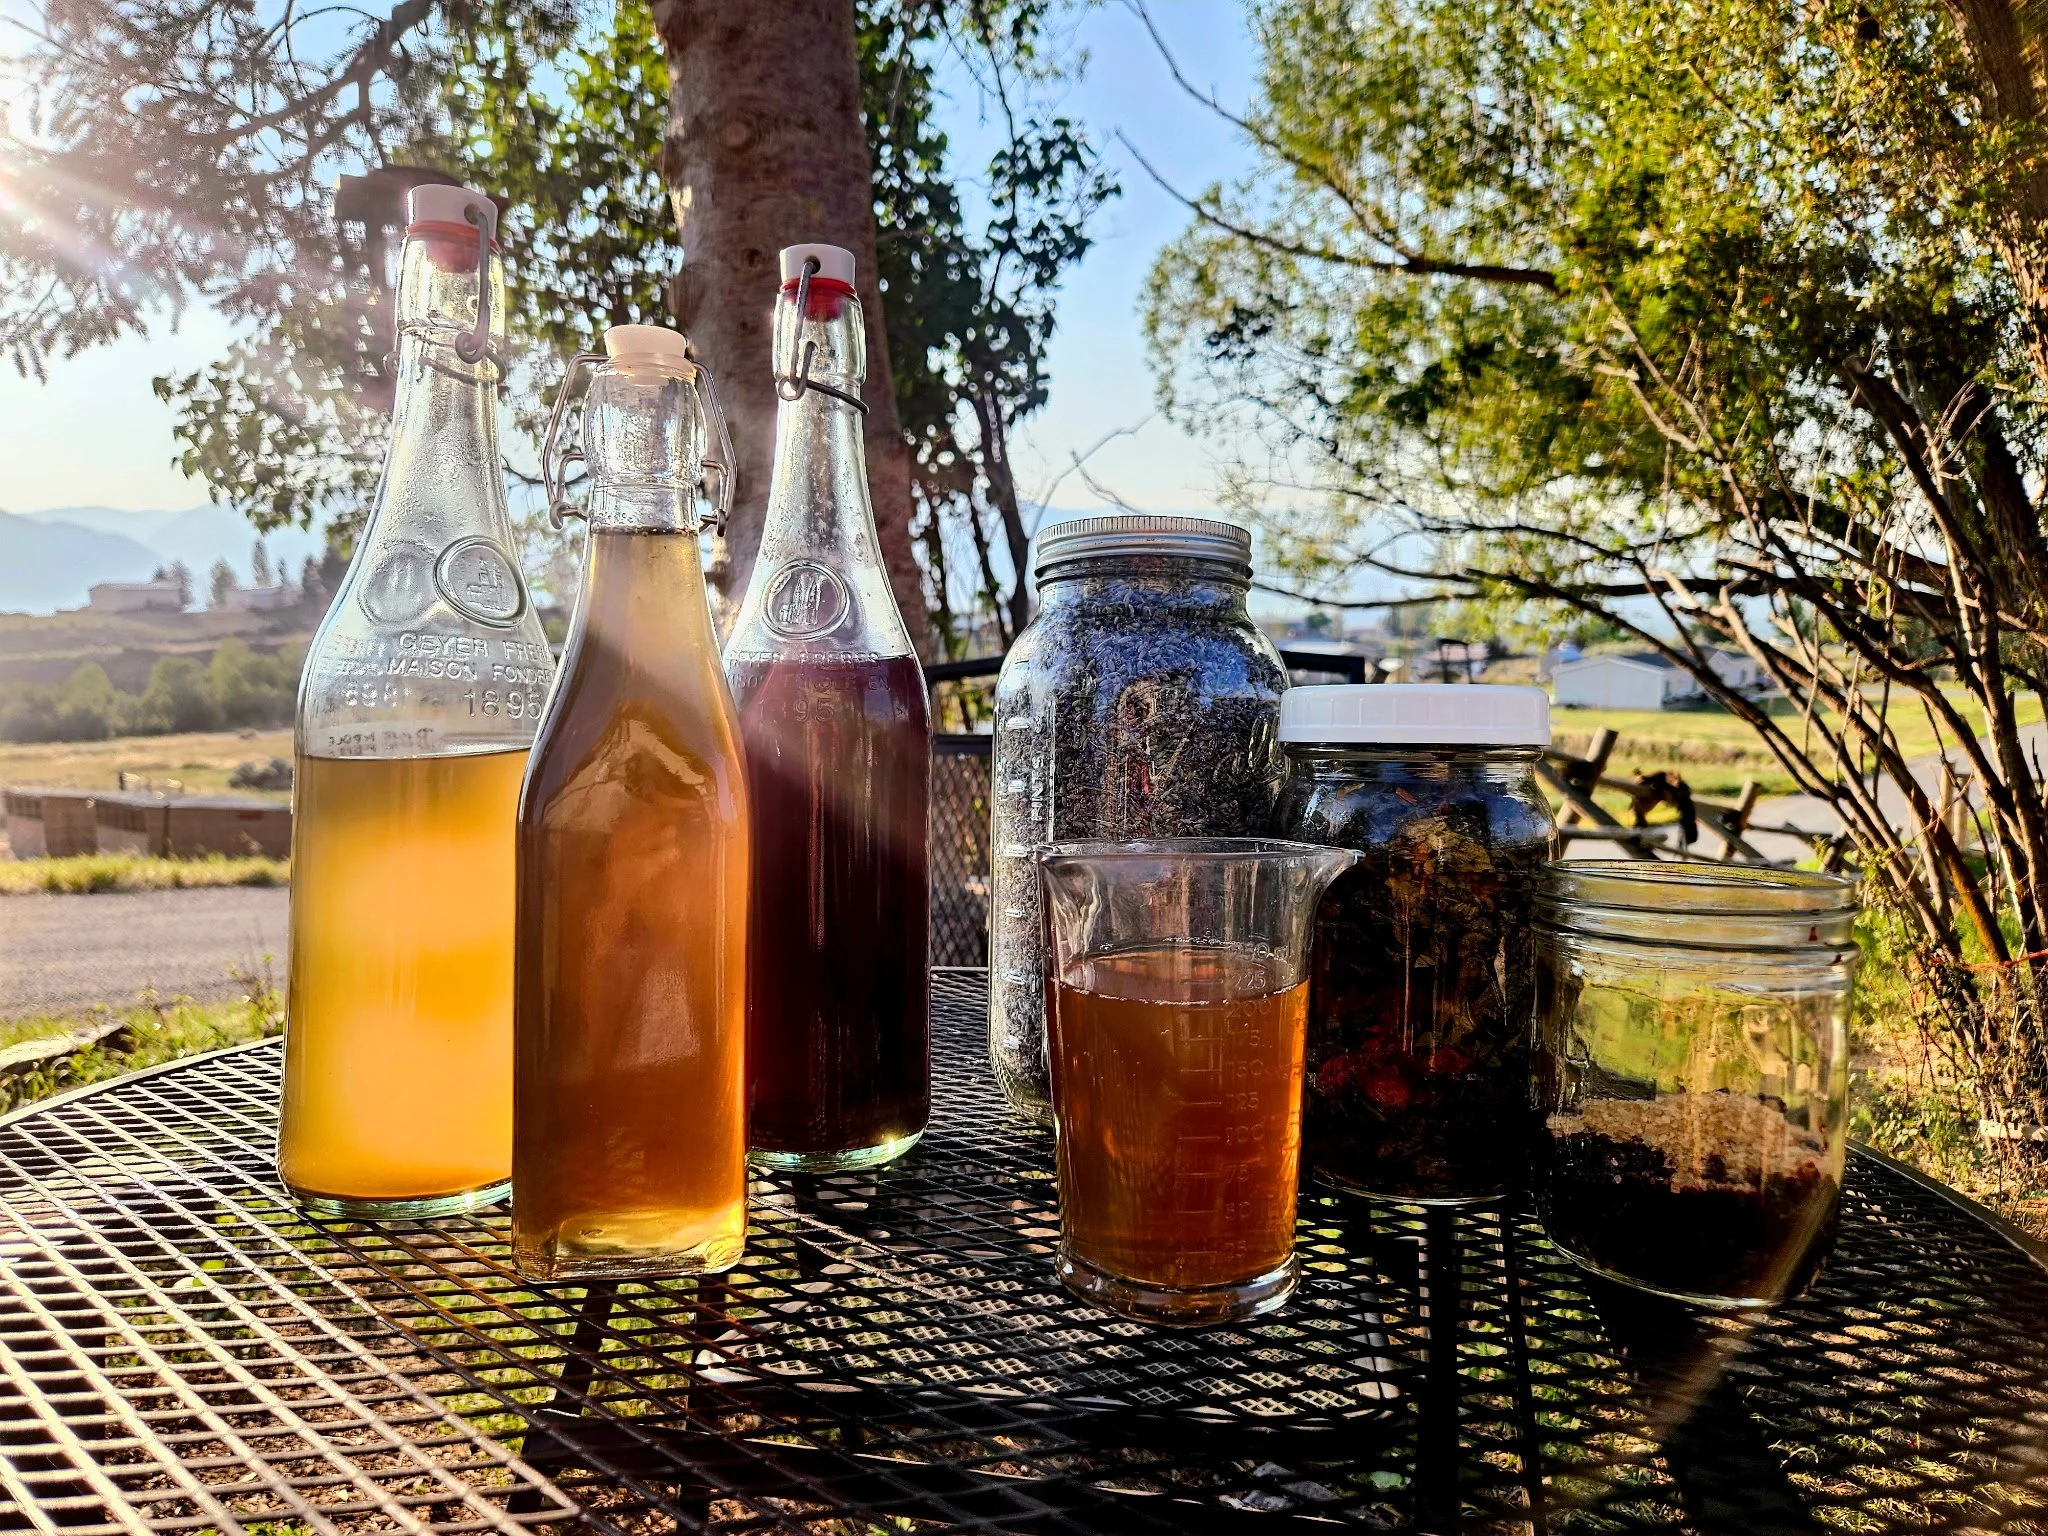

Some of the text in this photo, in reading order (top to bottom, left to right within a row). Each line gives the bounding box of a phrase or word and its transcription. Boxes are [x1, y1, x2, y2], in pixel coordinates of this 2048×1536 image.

[399, 633, 488, 657] GEYER
[386, 657, 479, 681] MAISON
[463, 688, 543, 720] 1895
[1030, 755, 1044, 821] PINTS
[1231, 969, 1268, 991] 225
[1227, 999, 1272, 1018] 200
[1226, 1091, 1260, 1113] 125
[1224, 1122, 1265, 1145] 100
[1224, 1164, 1250, 1185] 75
[1225, 1200, 1252, 1223] 50
